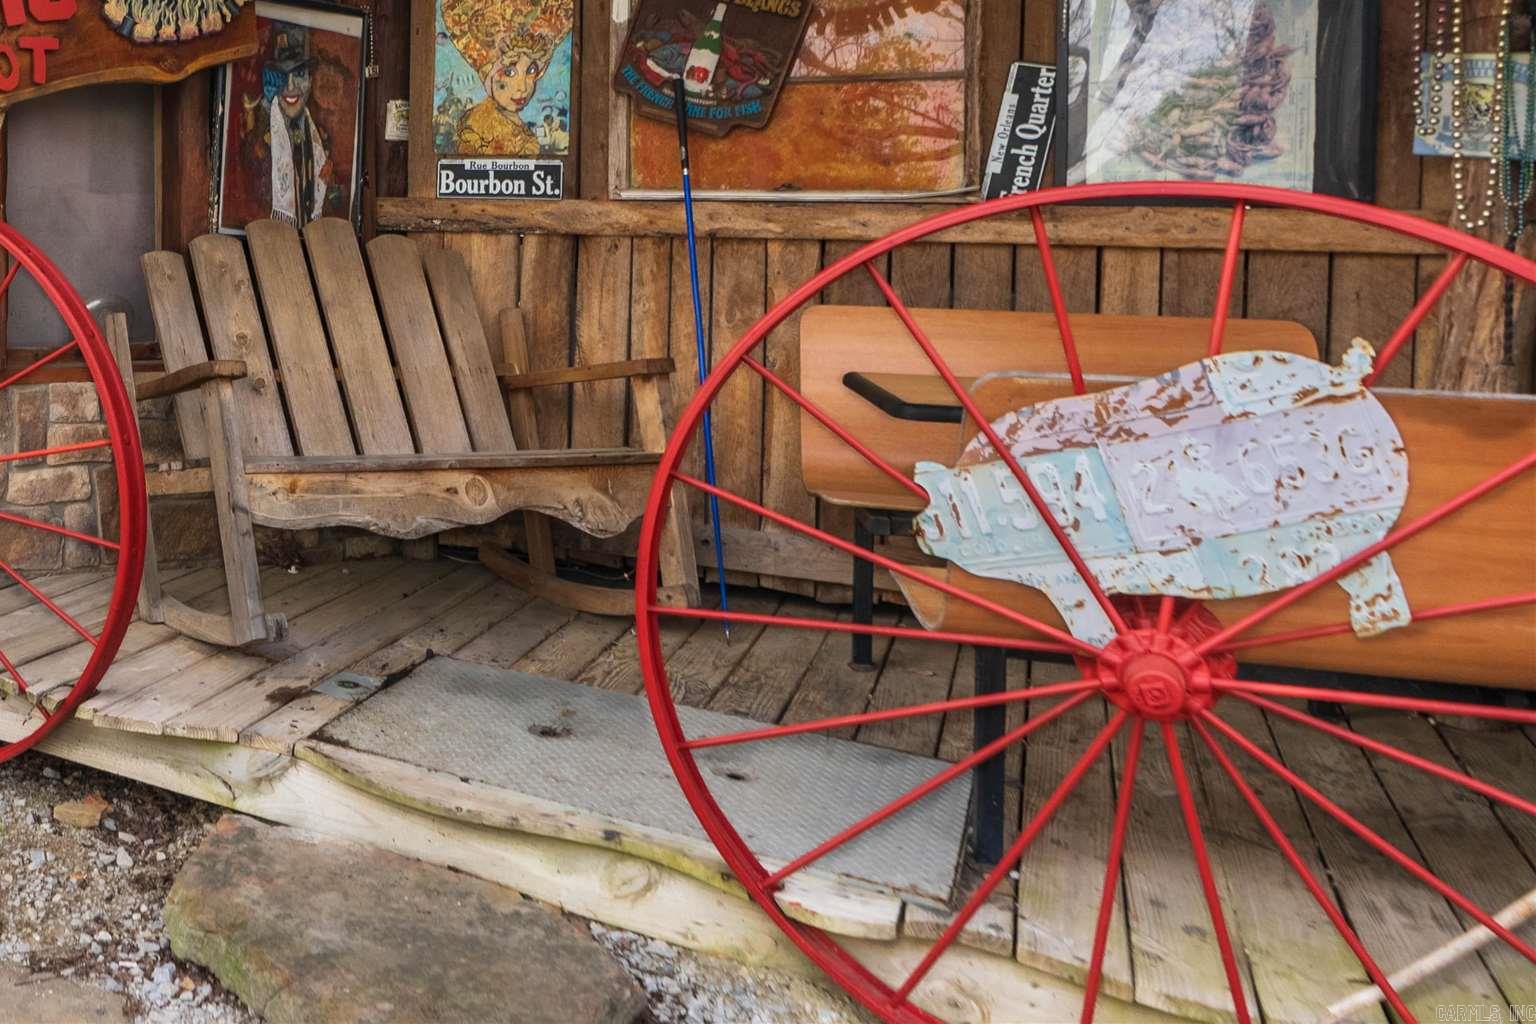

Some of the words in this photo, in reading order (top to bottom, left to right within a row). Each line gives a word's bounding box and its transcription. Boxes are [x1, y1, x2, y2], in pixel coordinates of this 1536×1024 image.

[1015, 67, 1056, 140] Quarter
[997, 103, 1017, 140] Orleans
[469, 161, 487, 171] Rue
[491, 161, 530, 171] Bourbon
[992, 144, 1006, 164] New
[439, 169, 526, 195] Bourbon
[531, 170, 561, 196] St.
